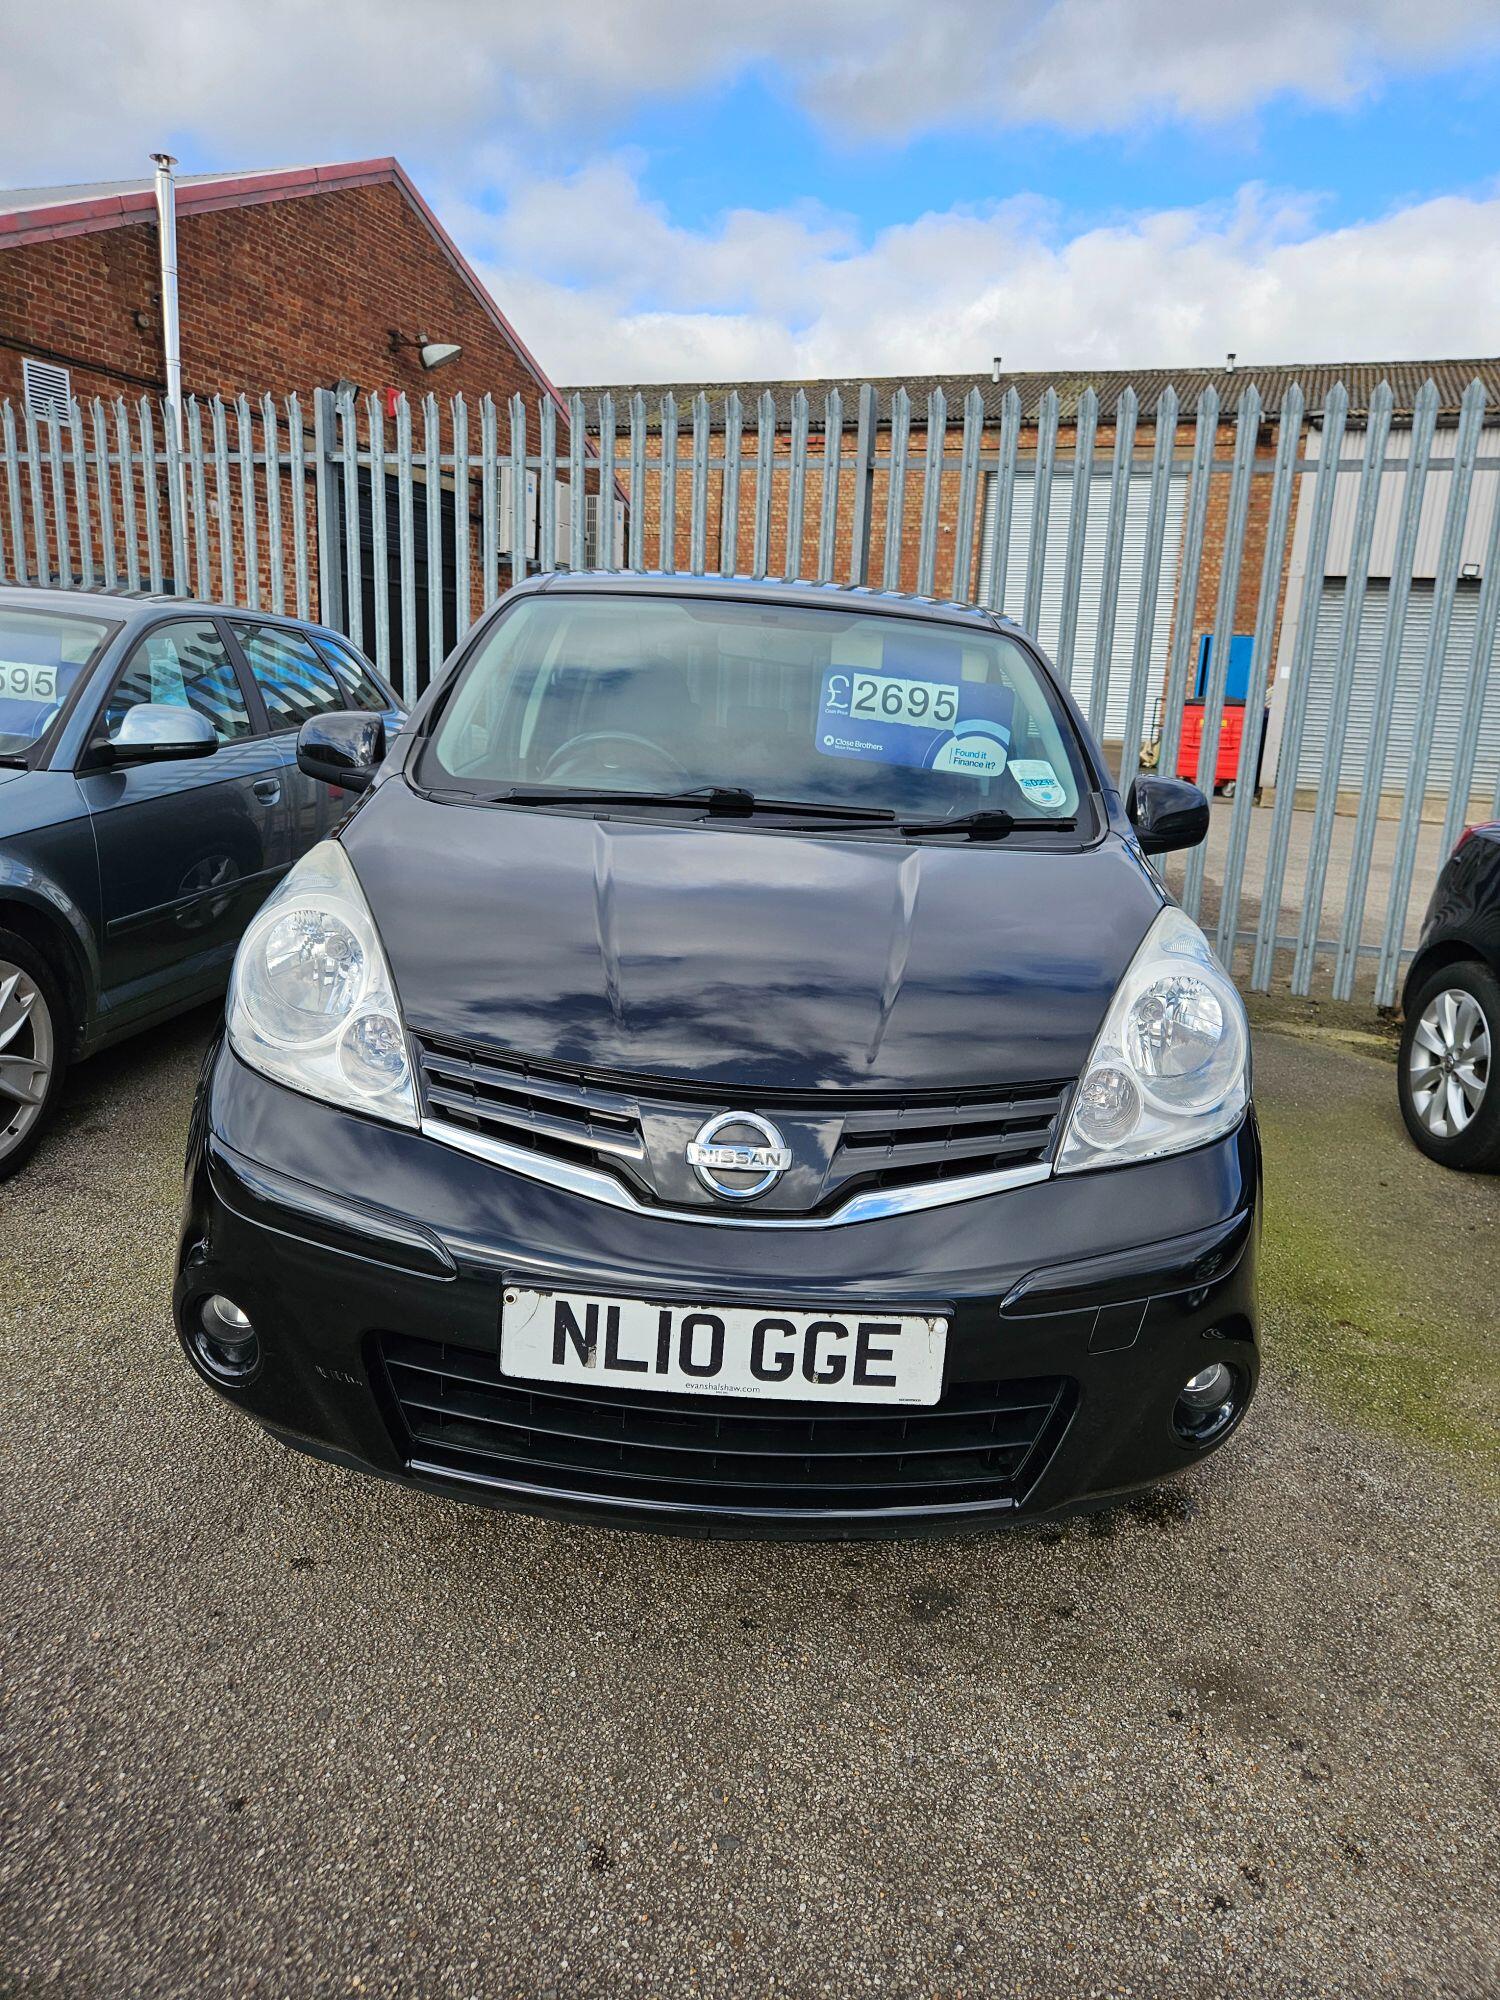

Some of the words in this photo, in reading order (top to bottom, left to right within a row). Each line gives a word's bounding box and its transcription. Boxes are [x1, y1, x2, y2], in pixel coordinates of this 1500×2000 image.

[0, 667, 53, 696] 95
[835, 738, 854, 747] Close
[854, 740, 884, 751] Brothers
[955, 748, 980, 759] Found
[981, 751, 987, 759] it
[953, 757, 984, 768] Finance
[985, 761, 996, 770] it?
[698, 1148, 781, 1166] NISSAN
[552, 1300, 726, 1378] NL10
[750, 1318, 902, 1388] GGE
[685, 1382, 761, 1393] evanshalshaw.com
